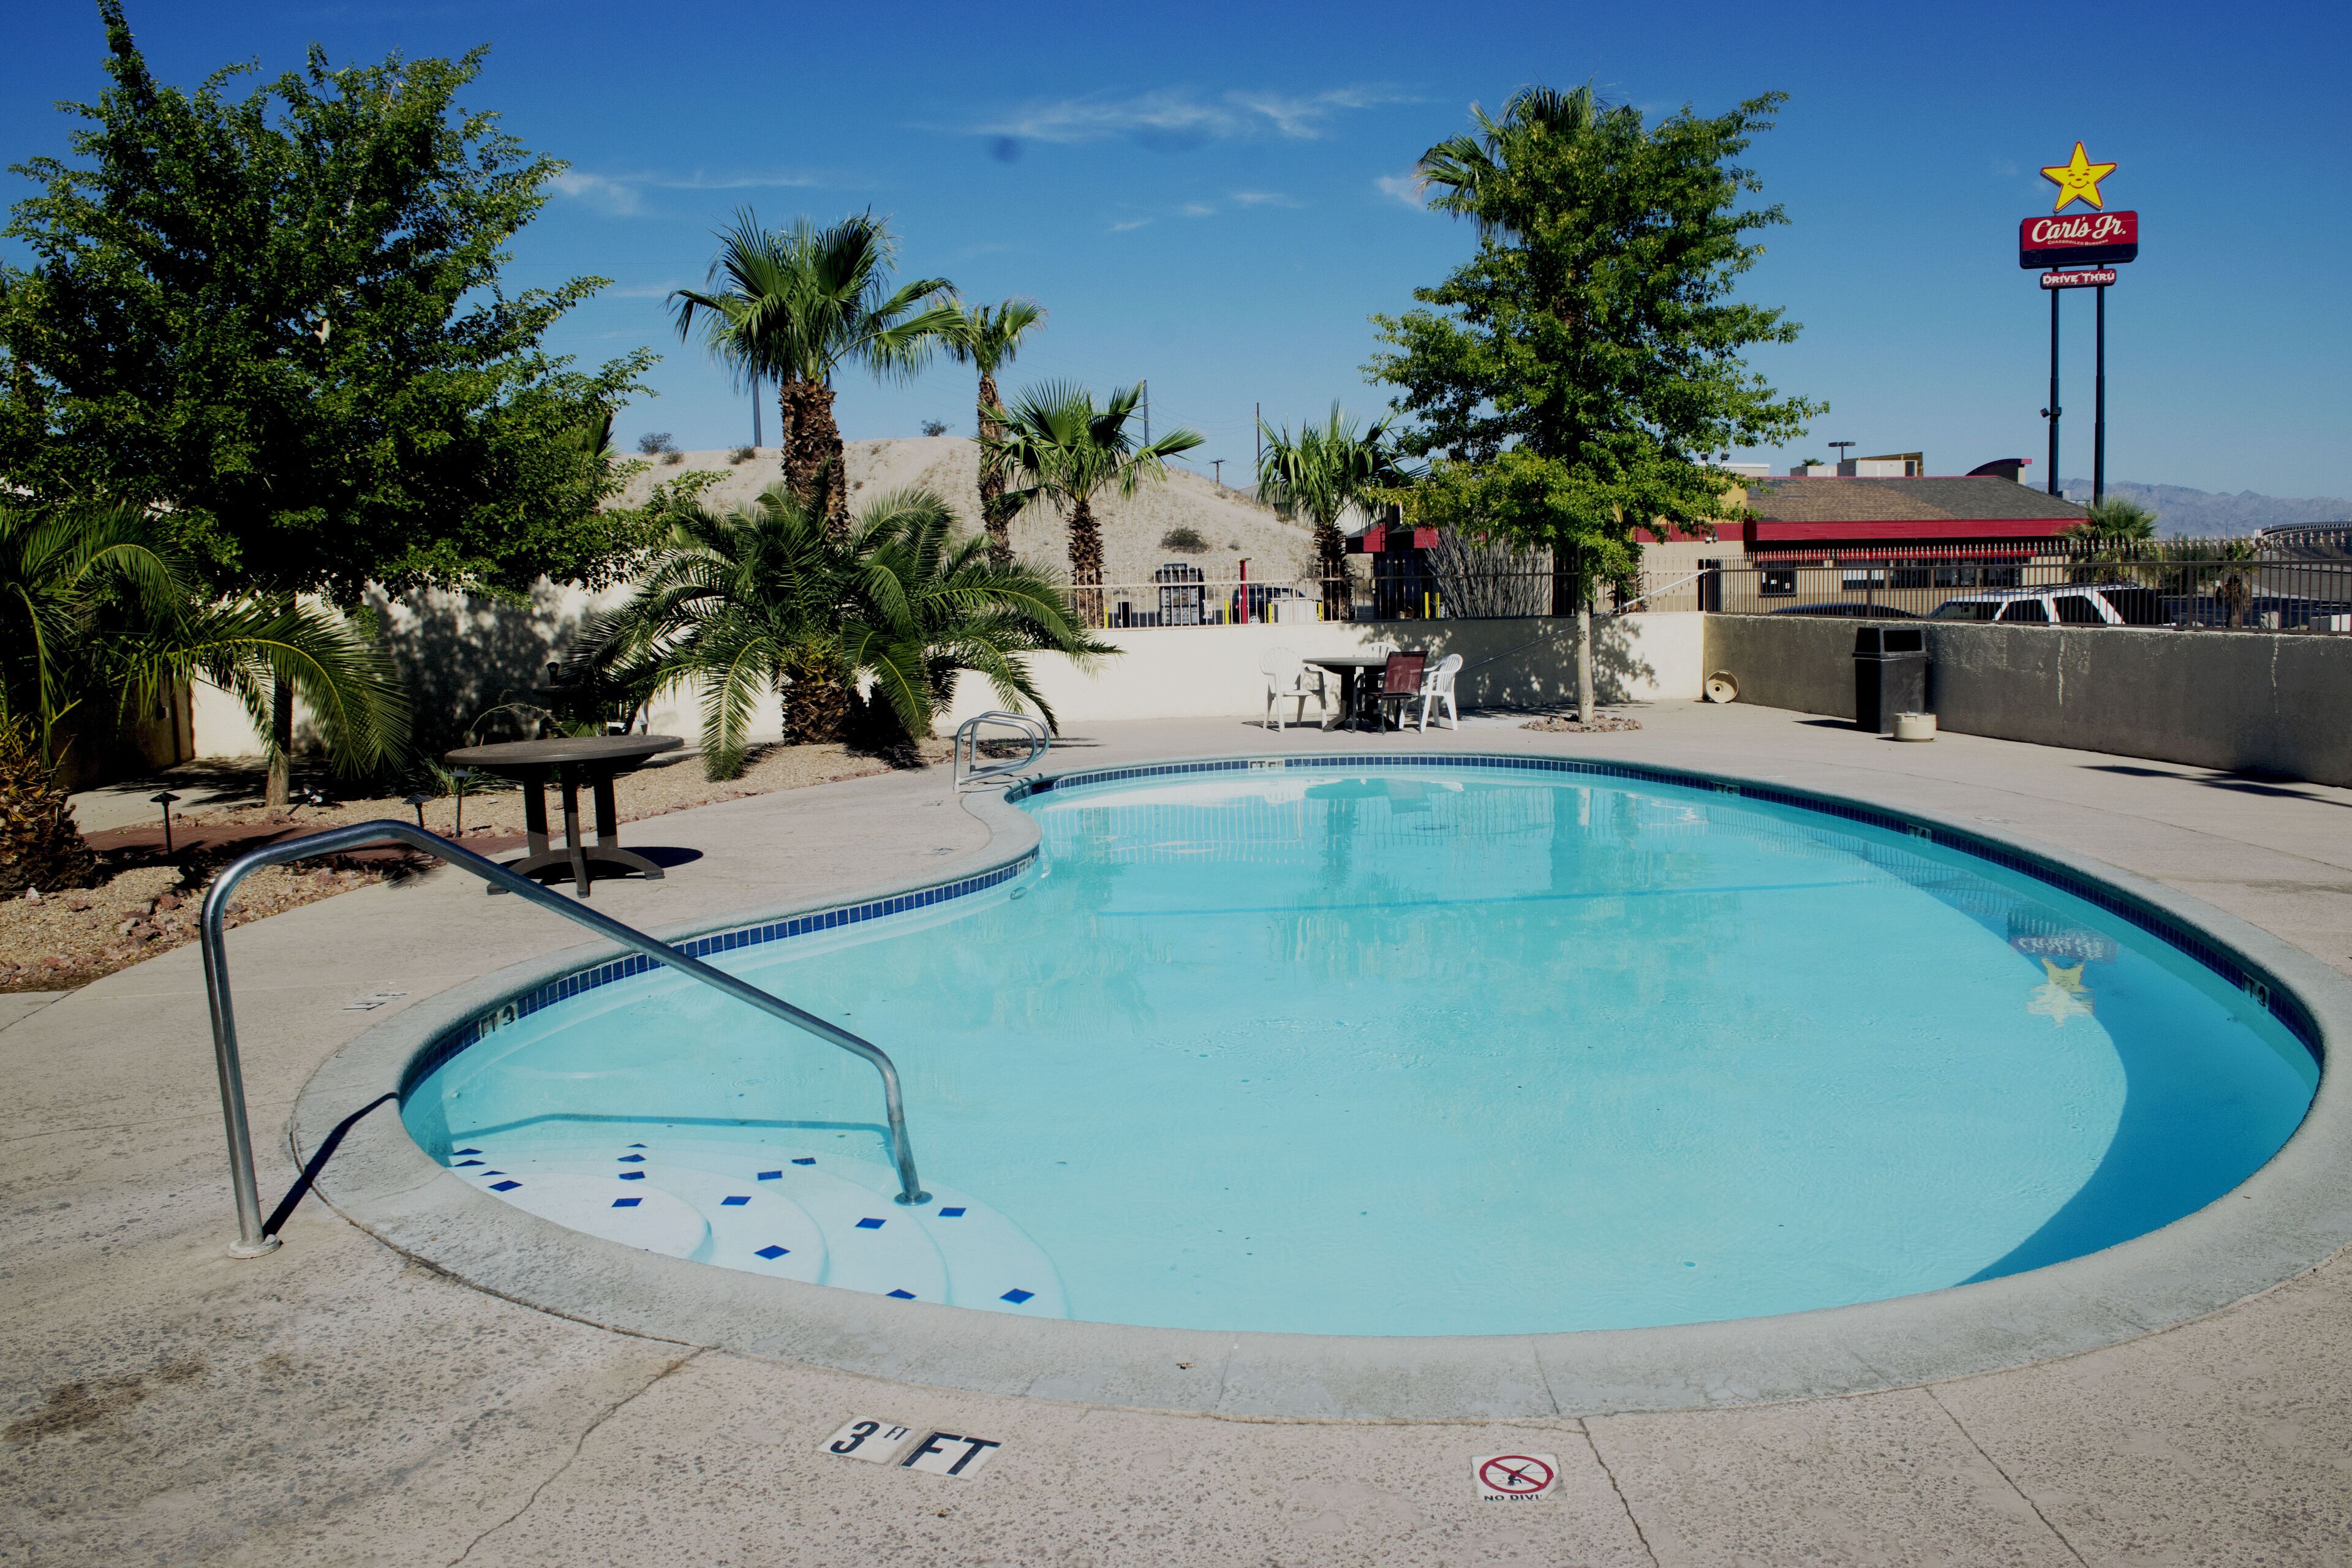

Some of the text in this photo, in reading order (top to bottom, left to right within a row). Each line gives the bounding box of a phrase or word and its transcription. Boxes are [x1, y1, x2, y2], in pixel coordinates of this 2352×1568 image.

[2032, 215, 2127, 243] Carl's Jr.
[2042, 272, 2115, 285] DRIVE THRU
[830, 1420, 1002, 1476] 3 FT FT
